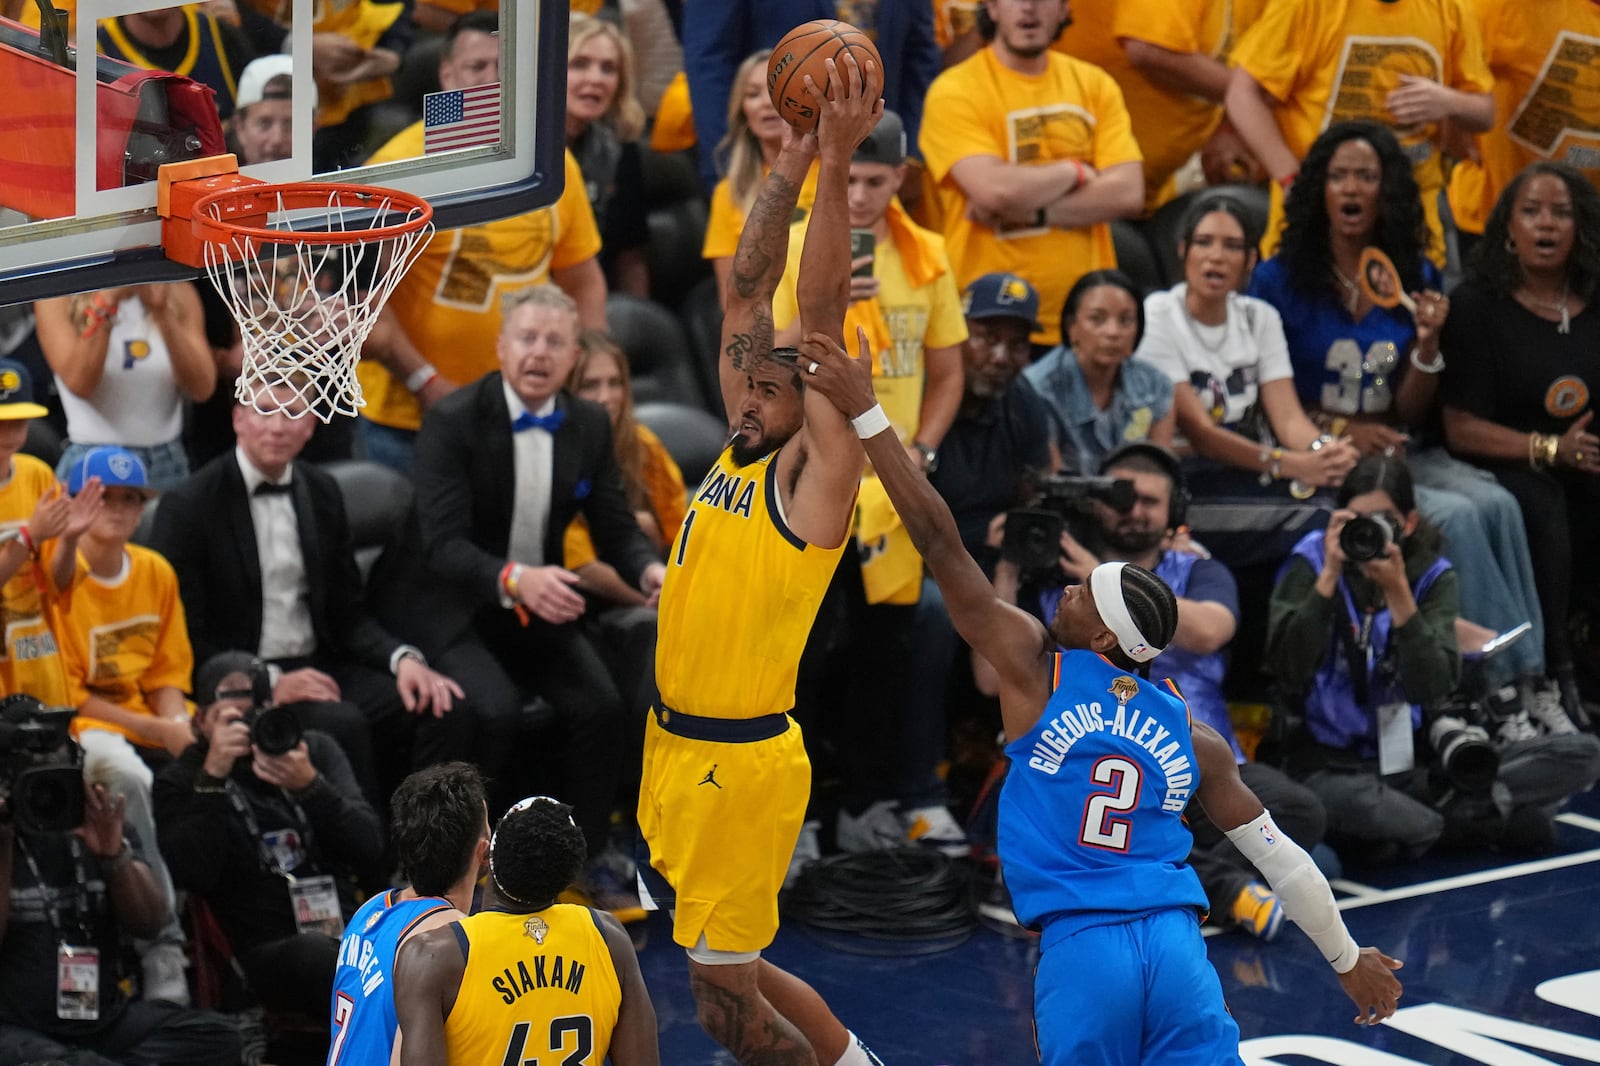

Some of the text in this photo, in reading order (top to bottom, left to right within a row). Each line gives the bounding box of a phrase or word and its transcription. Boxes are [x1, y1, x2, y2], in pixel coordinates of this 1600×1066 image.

[1029, 702, 1193, 812] GILGEOUS-ALEXANDER
[1078, 754, 1144, 854] 2
[492, 955, 586, 1005] SIAKAM
[328, 990, 355, 1066] 7
